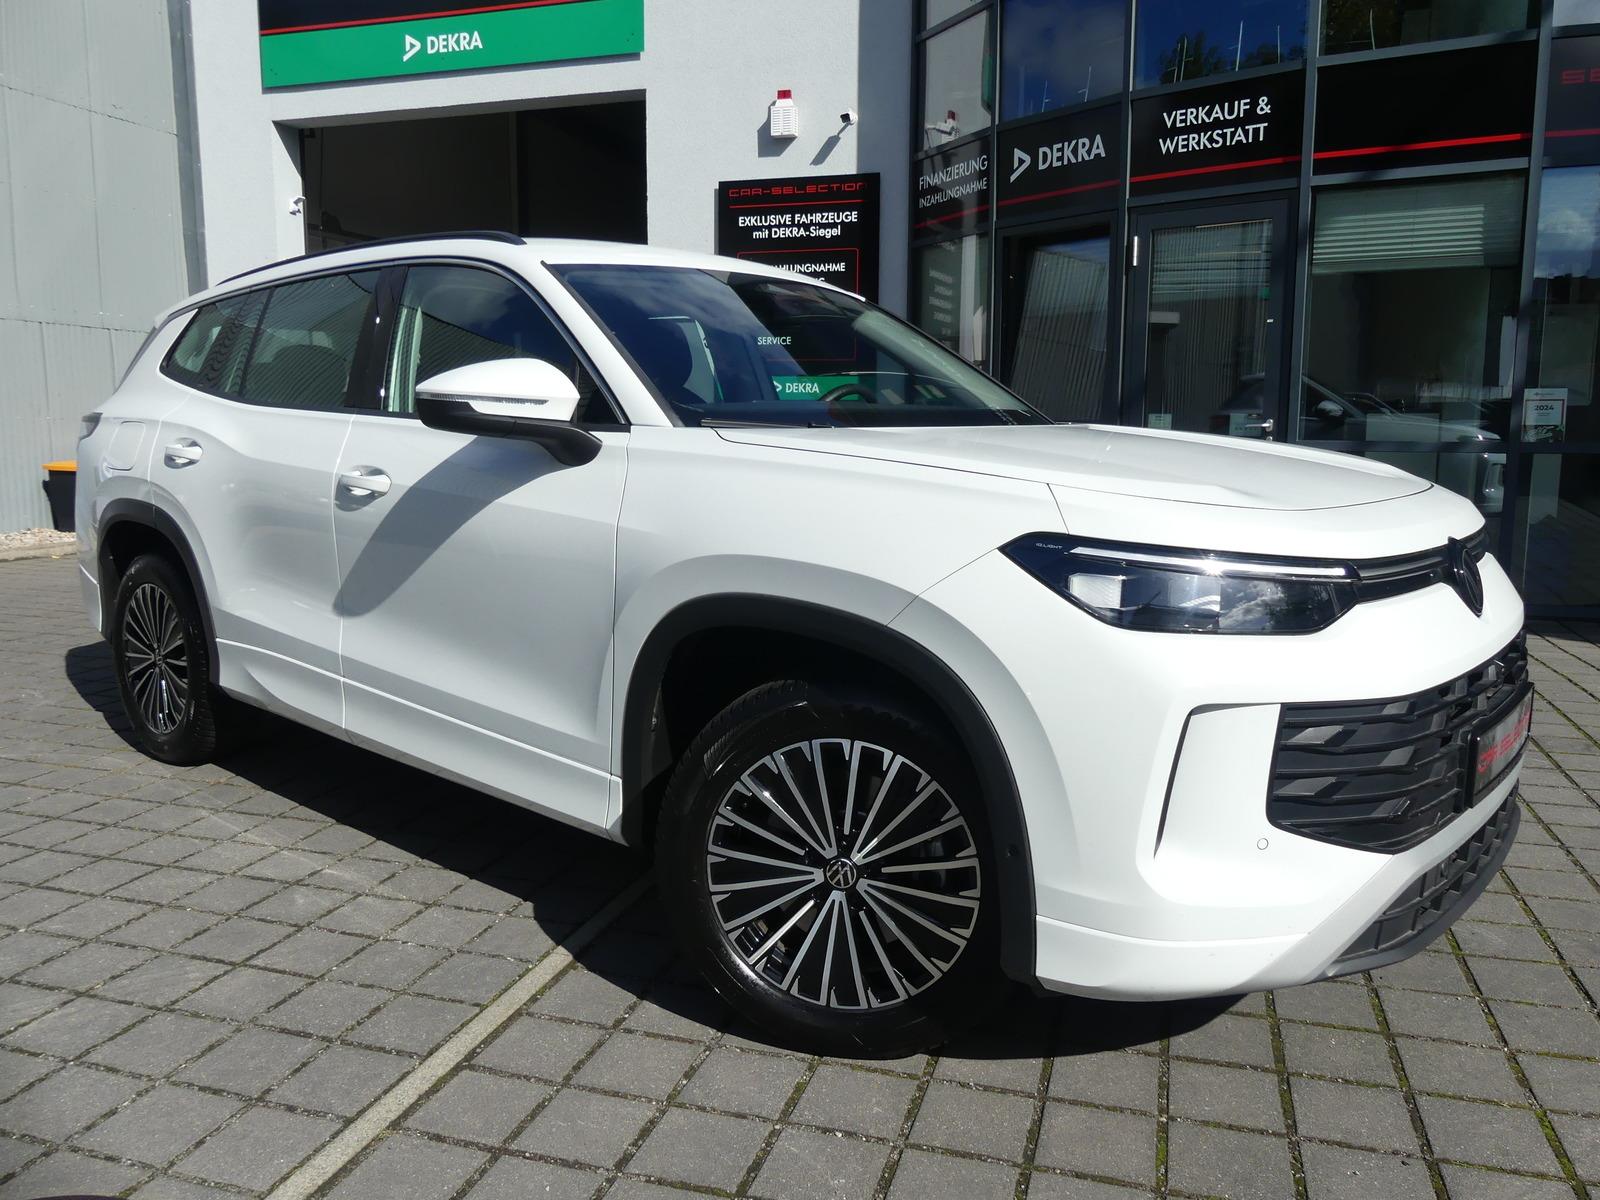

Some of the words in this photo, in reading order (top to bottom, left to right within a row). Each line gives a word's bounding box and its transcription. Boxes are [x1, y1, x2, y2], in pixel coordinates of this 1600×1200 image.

[426, 31, 483, 54] DEKRA
[1163, 99, 1250, 128] VERKAUF
[1256, 96, 1272, 115] &
[1038, 134, 1106, 171] DEKRA
[1159, 123, 1268, 155] WERKSTATT
[919, 155, 988, 190] FINANZIERUNG
[919, 177, 988, 208] INZAHLUNGNAHME
[738, 214, 791, 226] EXKLUSIVE
[795, 211, 858, 224] FAHRZEUGE
[753, 229, 769, 239] mit
[771, 225, 841, 239] DEKRA-Siegel
[757, 336, 792, 346] SERVICE
[785, 382, 820, 394] DEKRA
